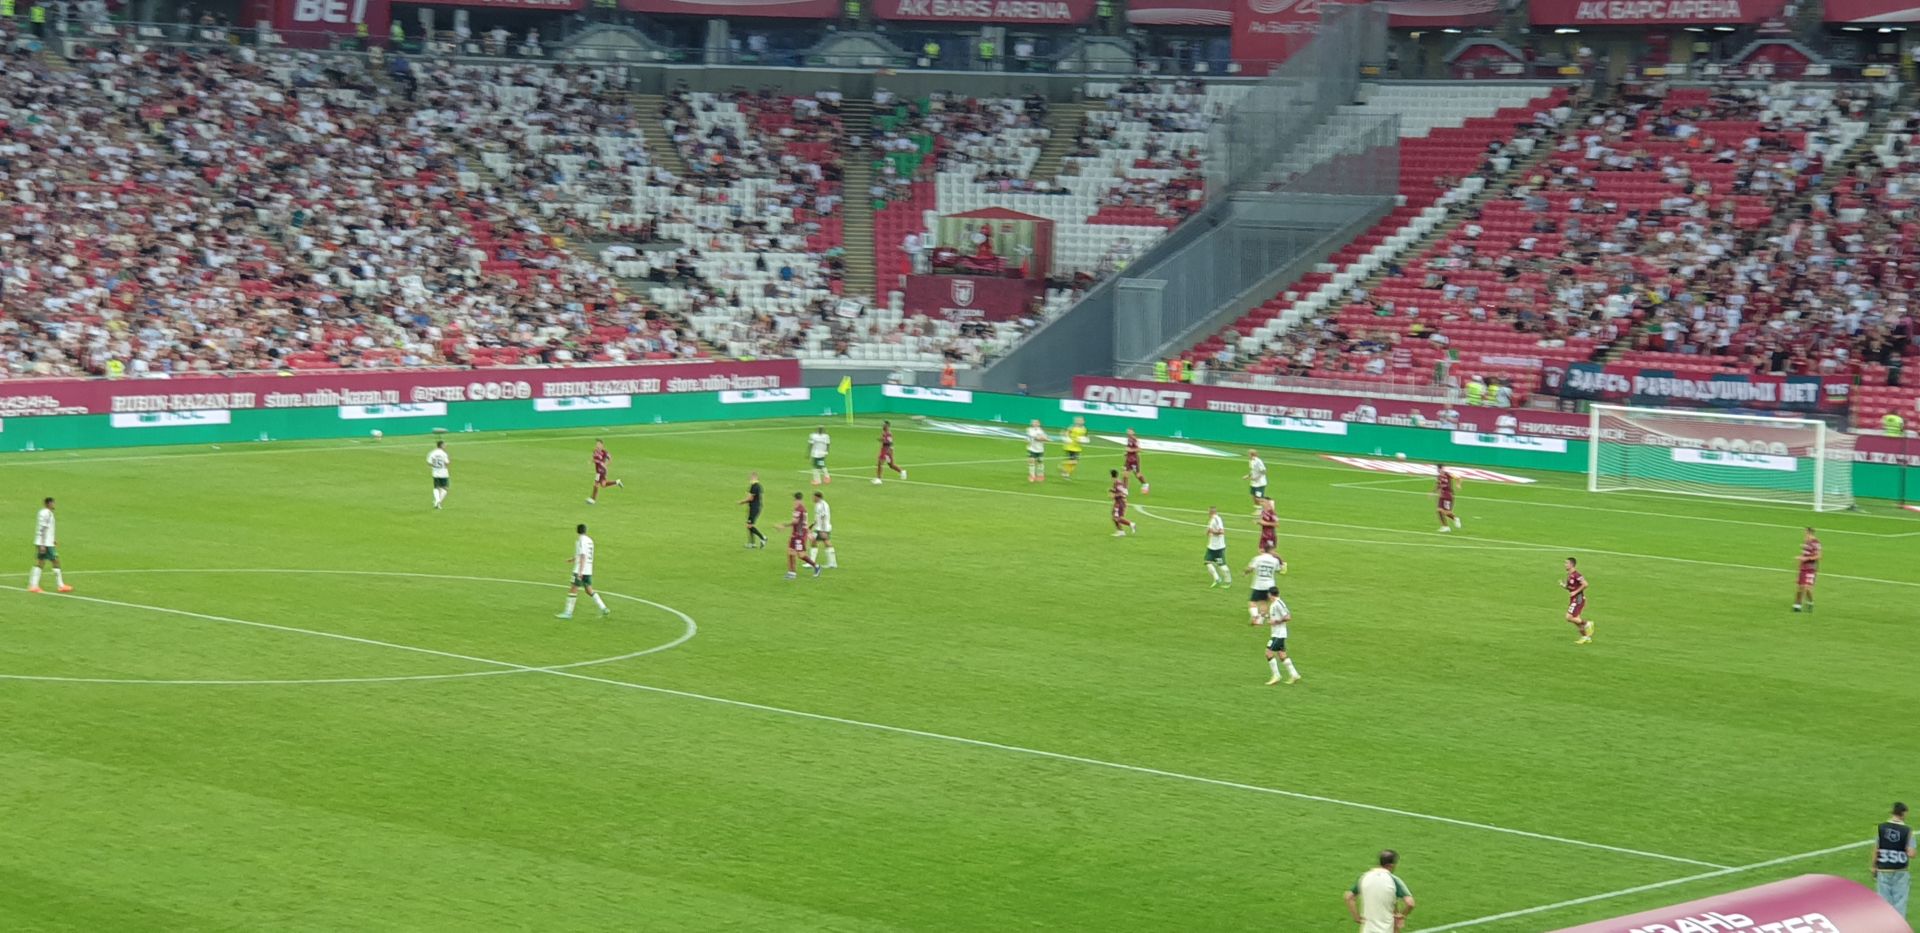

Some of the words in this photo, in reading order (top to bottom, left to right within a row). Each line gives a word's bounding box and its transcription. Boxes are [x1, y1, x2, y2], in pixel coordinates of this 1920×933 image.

[932, 0, 993, 17] BARS
[994, 1, 1071, 19] ARENA
[1608, 1, 1666, 19] БАРС
[1666, 1, 1741, 19] АРЕНА
[410, 385, 466, 402] @FCRK
[543, 378, 661, 397] RUBIN-KAZAN.RU
[1568, 368, 1631, 393] ЗДЕСЬ
[1633, 375, 1777, 402] РАВНОДУШНЫХ
[1780, 382, 1819, 402] НЕТ
[112, 393, 256, 412] RUBIN-KAZAN.RU
[264, 387, 400, 407] store.rubin-kazan.ru
[1878, 849, 1908, 864] 350
